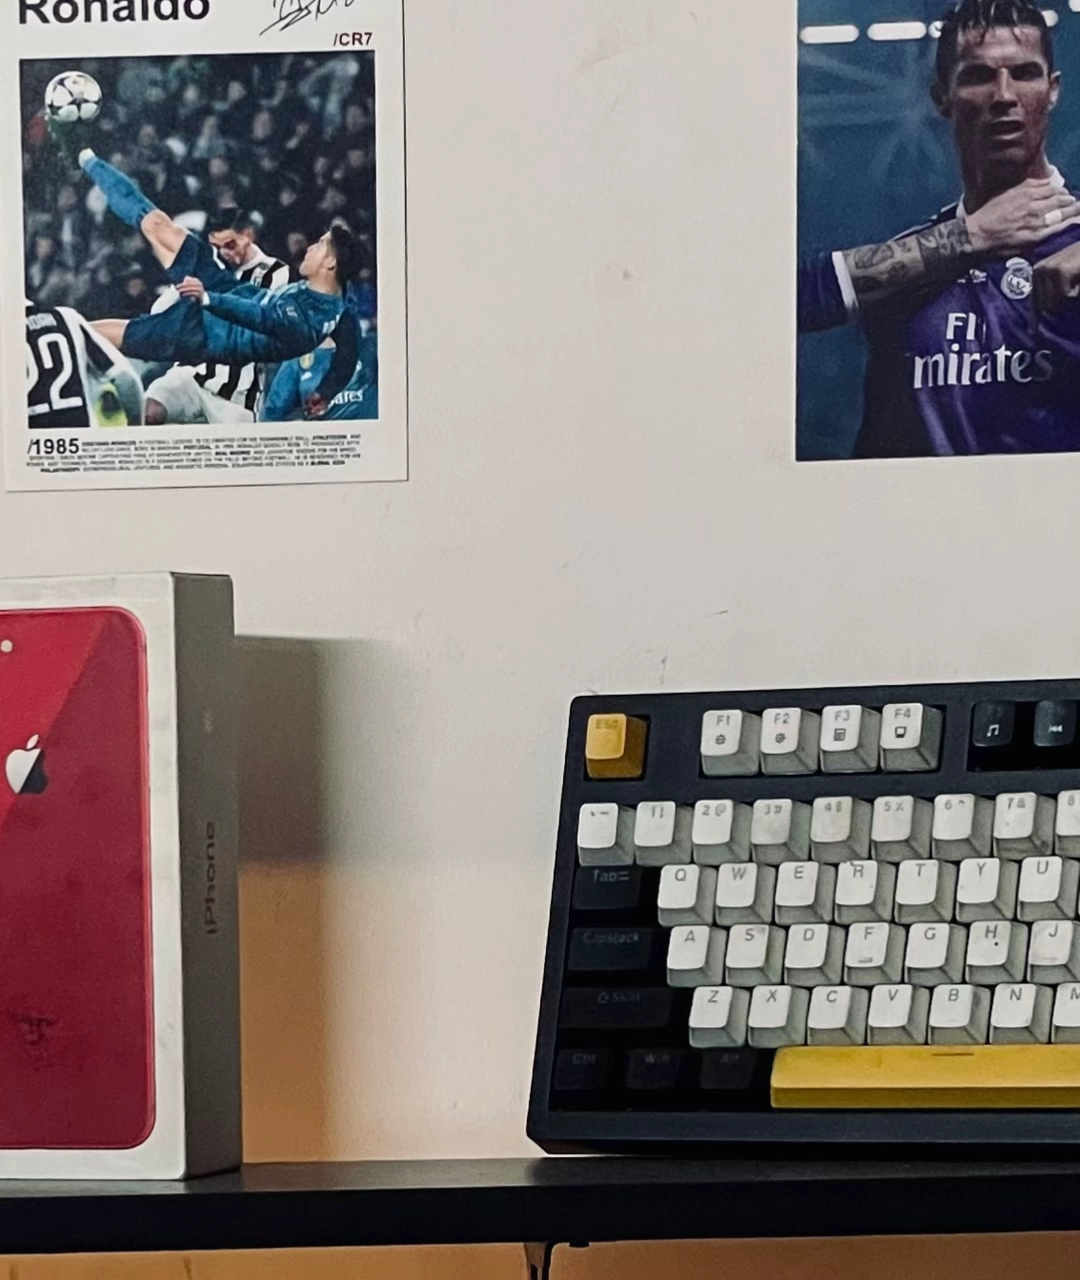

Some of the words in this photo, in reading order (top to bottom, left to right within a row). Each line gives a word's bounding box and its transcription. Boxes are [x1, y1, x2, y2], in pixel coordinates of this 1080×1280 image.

[333, 32, 373, 47] /CR7
[913, 343, 1054, 389] mirates
[27, 437, 80, 455] /1985
[716, 714, 731, 727] F1
[774, 712, 790, 725] F2
[834, 710, 850, 722] F3
[894, 707, 911, 720] F4
[204, 821, 218, 935] iPhone
[675, 867, 687, 882] Q
[731, 866, 748, 881] W
[793, 865, 805, 879] E
[852, 863, 865, 878] R
[915, 863, 926, 877] T
[976, 861, 986, 876] Y
[1036, 860, 1049, 875] U
[684, 930, 696, 943] A
[744, 928, 755, 942] S
[803, 928, 815, 942] D
[863, 927, 874, 940] F
[924, 927, 936, 940] G
[984, 924, 998, 939] H
[1048, 923, 1059, 938] J
[707, 990, 720, 1003] Z
[766, 989, 778, 1002] X
[826, 990, 838, 1003] C
[888, 989, 899, 1001] V
[948, 988, 959, 1001] B
[1009, 987, 1022, 1001] N
